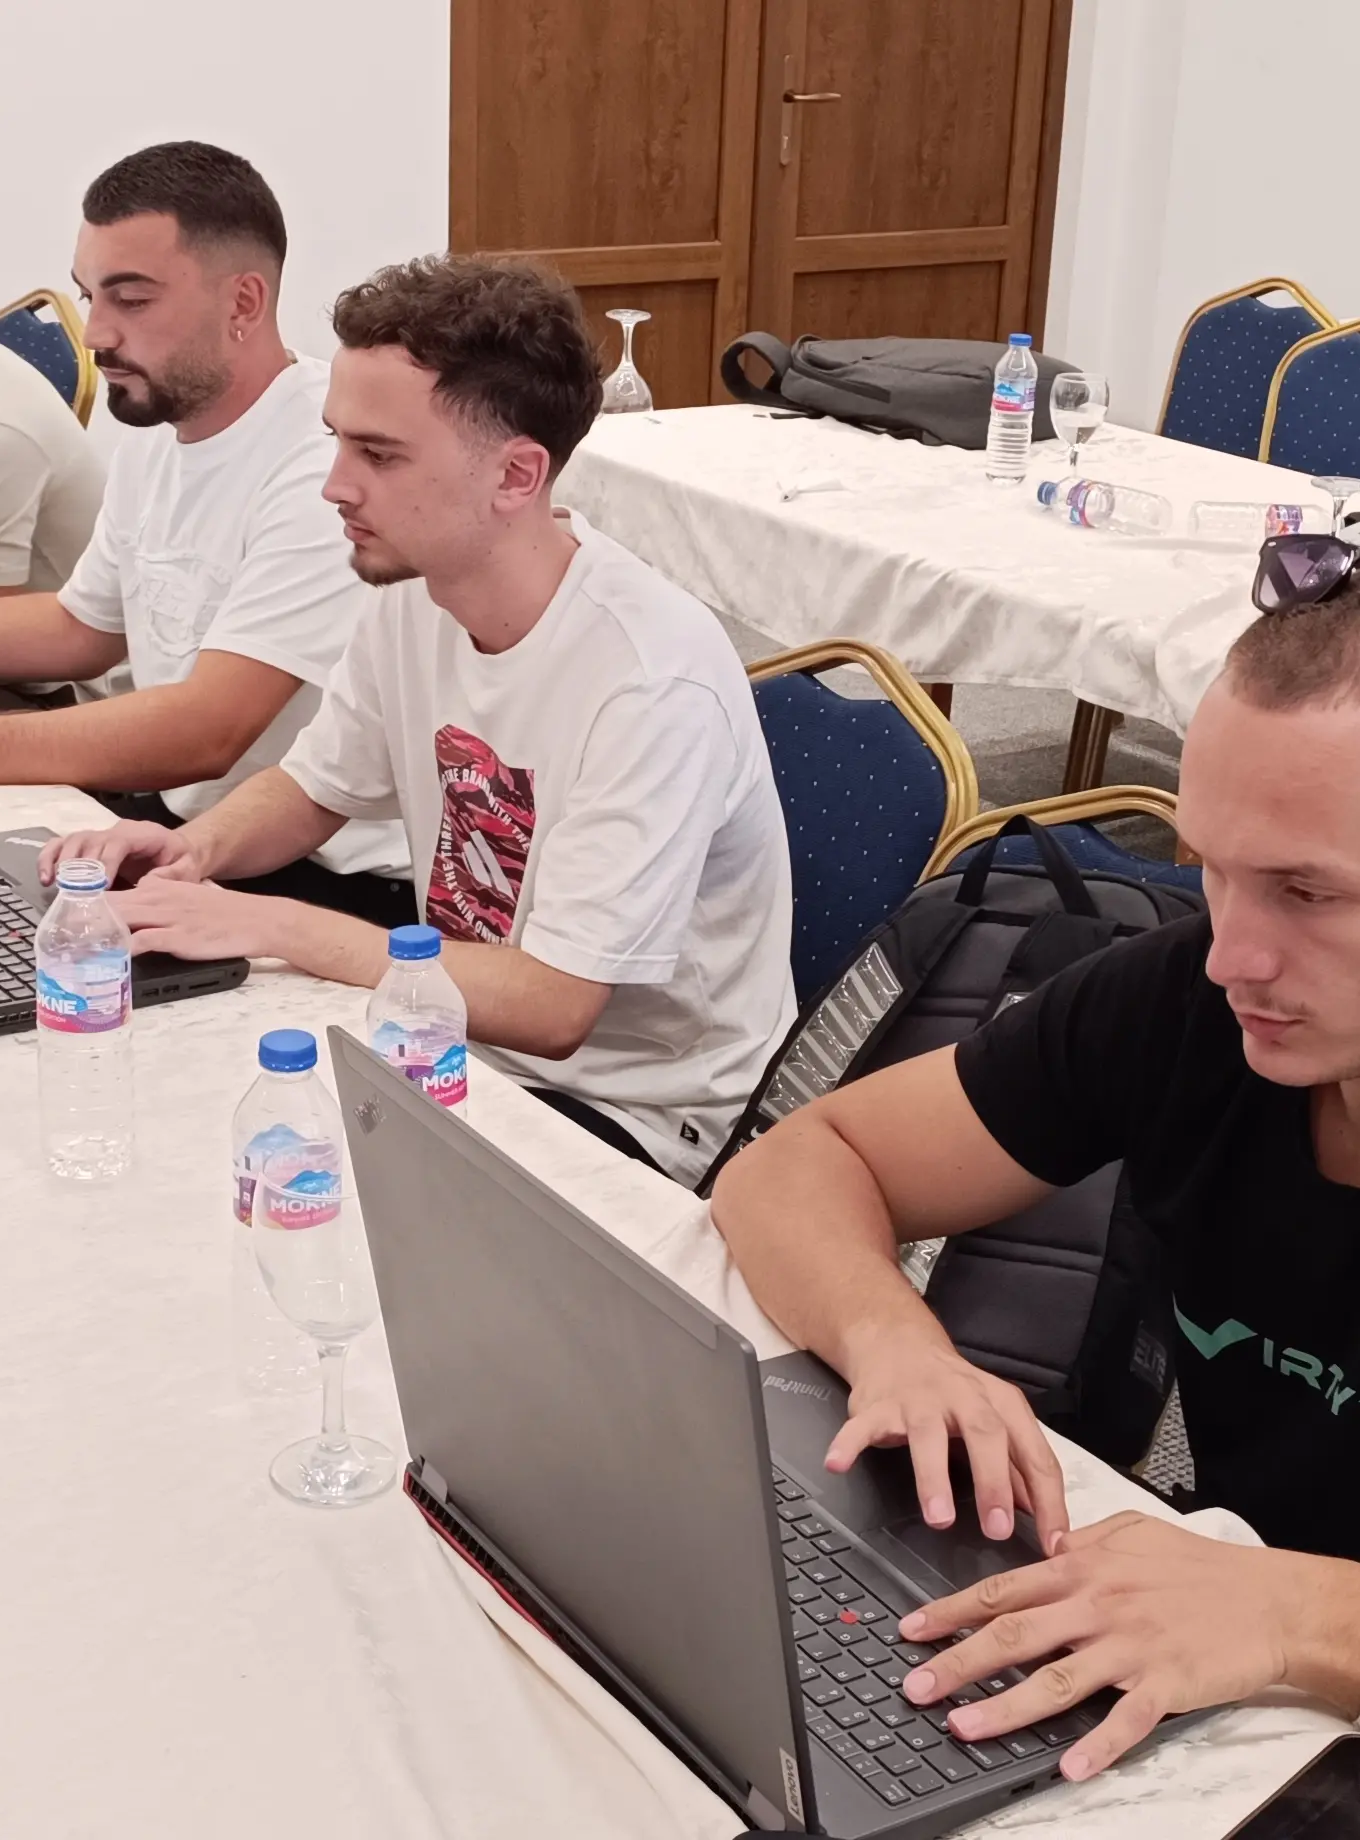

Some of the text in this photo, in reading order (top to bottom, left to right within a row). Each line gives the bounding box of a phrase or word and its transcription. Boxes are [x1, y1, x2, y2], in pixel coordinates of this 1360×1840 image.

[444, 766, 460, 784] THE
[512, 825, 532, 852] THE
[443, 860, 459, 891] THE
[452, 890, 476, 926] WITH
[37, 991, 78, 1015] KNE
[762, 1374, 832, 1402] ThinkPad
[785, 1758, 800, 1816] Lenovo
